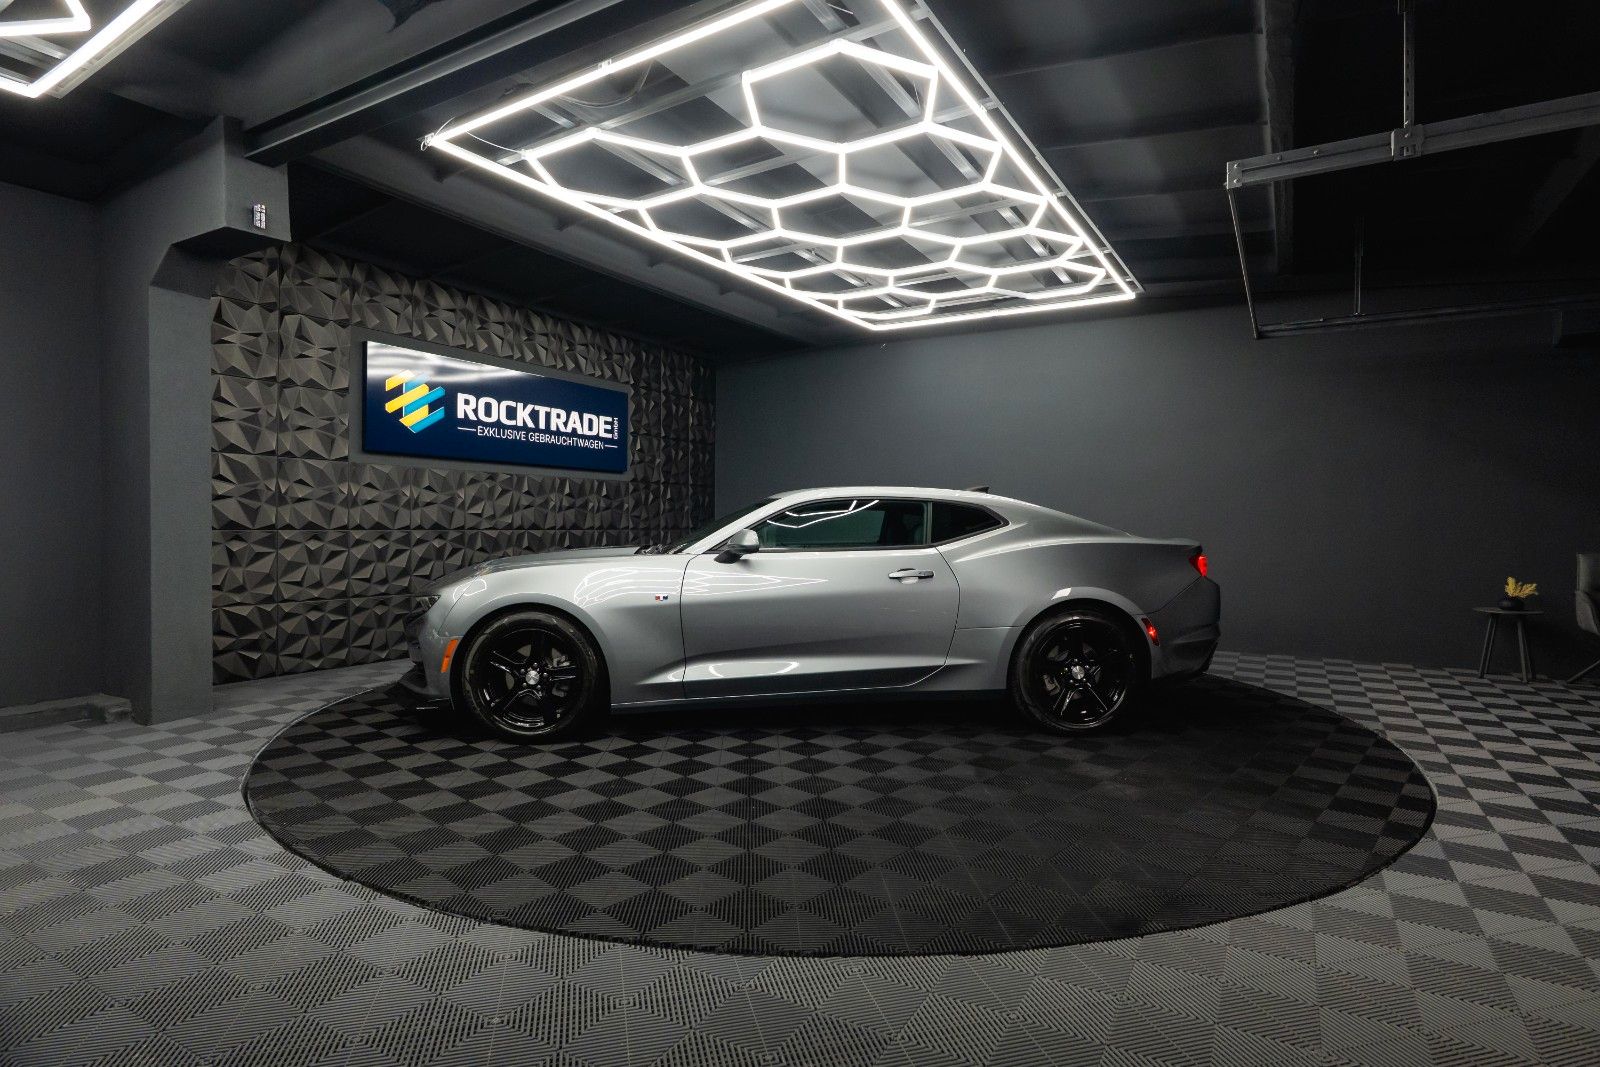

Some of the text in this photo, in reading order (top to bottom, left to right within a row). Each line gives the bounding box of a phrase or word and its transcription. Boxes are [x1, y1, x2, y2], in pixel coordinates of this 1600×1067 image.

[457, 392, 613, 438] ROCKTRADE
[477, 425, 604, 450] EXKLUSIVE GEBRAUCHTWAGEN
